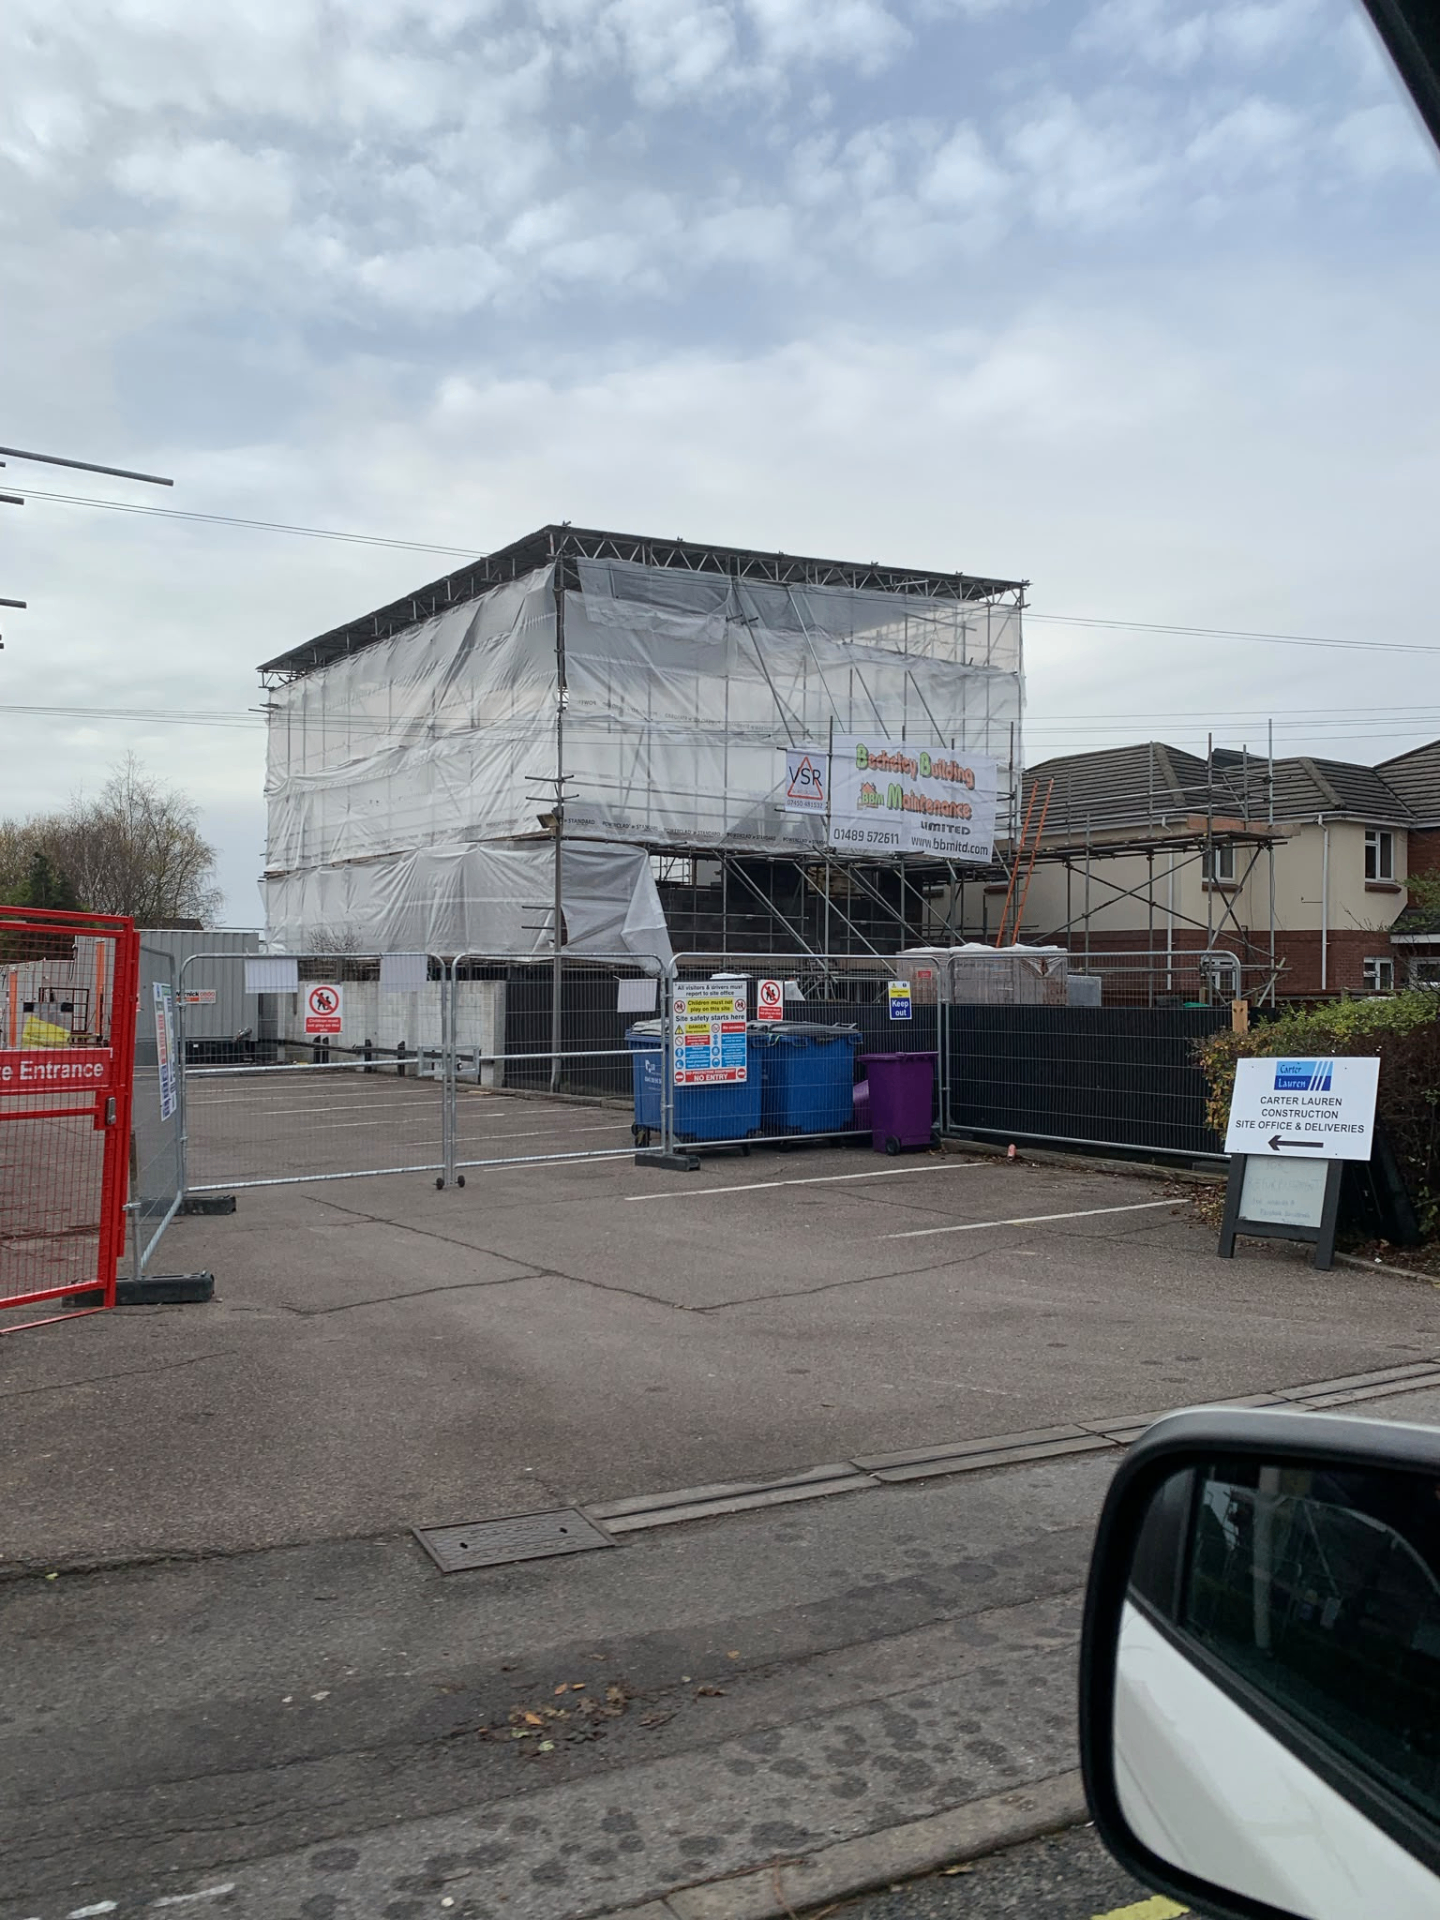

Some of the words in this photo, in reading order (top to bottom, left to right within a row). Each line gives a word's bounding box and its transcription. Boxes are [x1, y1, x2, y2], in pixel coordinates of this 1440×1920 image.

[789, 766, 822, 786] VSR
[920, 752, 975, 790] Building
[887, 783, 972, 820] Maintenance
[834, 828, 864, 842] 01489
[866, 831, 899, 844] 572611
[892, 1000, 909, 1008] Keep
[20, 1061, 104, 1080] Entrance
[1280, 1064, 1302, 1074] Carter
[1278, 1078, 1306, 1088] Lauren
[1260, 1096, 1299, 1105] CARTER
[1301, 1097, 1342, 1106] LAUREN
[1261, 1108, 1339, 1119] CONSTRUCTION
[1235, 1120, 1256, 1129] SITE
[1258, 1120, 1292, 1130] OFFICE
[1295, 1122, 1301, 1131] &
[1304, 1122, 1365, 1134] DELIVERIES
